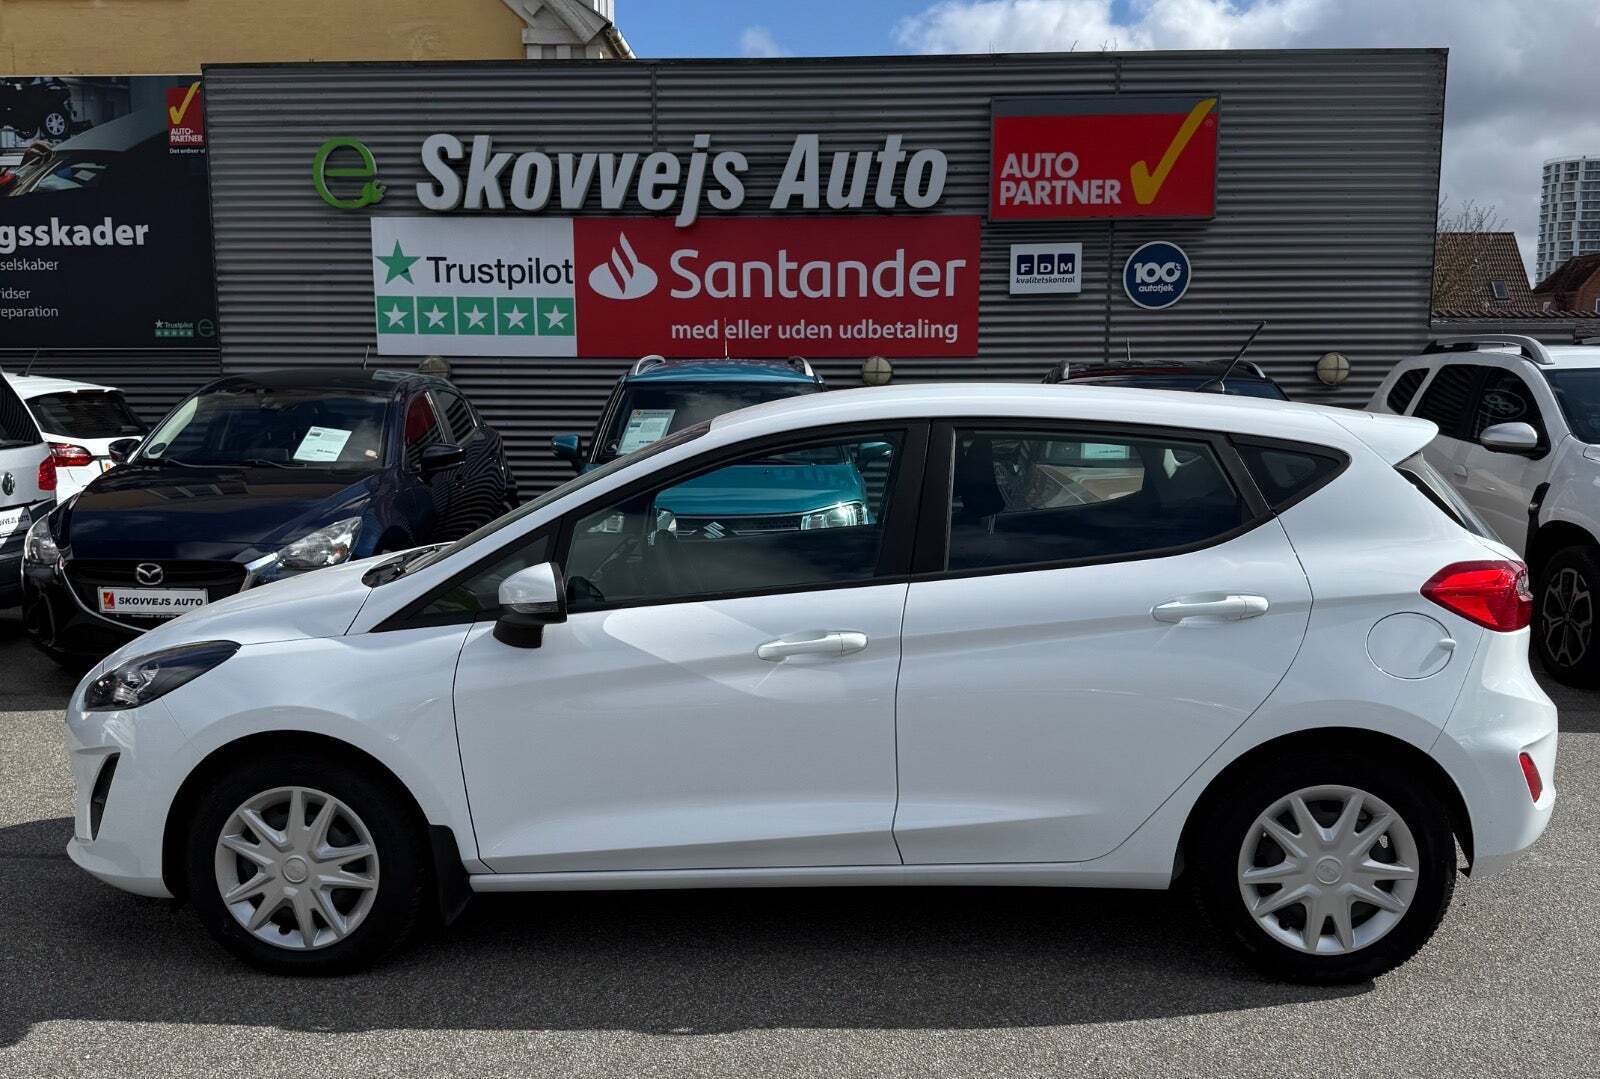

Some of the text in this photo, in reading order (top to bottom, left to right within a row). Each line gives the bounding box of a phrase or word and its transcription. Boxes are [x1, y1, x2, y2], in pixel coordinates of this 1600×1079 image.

[170, 134, 203, 142] PARTNER
[1000, 152, 1079, 178] AUTO
[416, 133, 948, 228] Skovvejs Auto
[1000, 179, 1121, 205] PARTNER
[0, 217, 149, 254] gsskader
[0, 258, 59, 271] selskaber
[426, 256, 574, 290] Trustpilot
[669, 248, 966, 299] Santander
[1019, 261, 1074, 274] FDM
[1015, 276, 1076, 284] kvalitetskontrol
[0, 306, 59, 319] eparation
[671, 318, 959, 343] med eller uden udbetaling
[118, 597, 204, 606] SKOVVEJS AUTO
